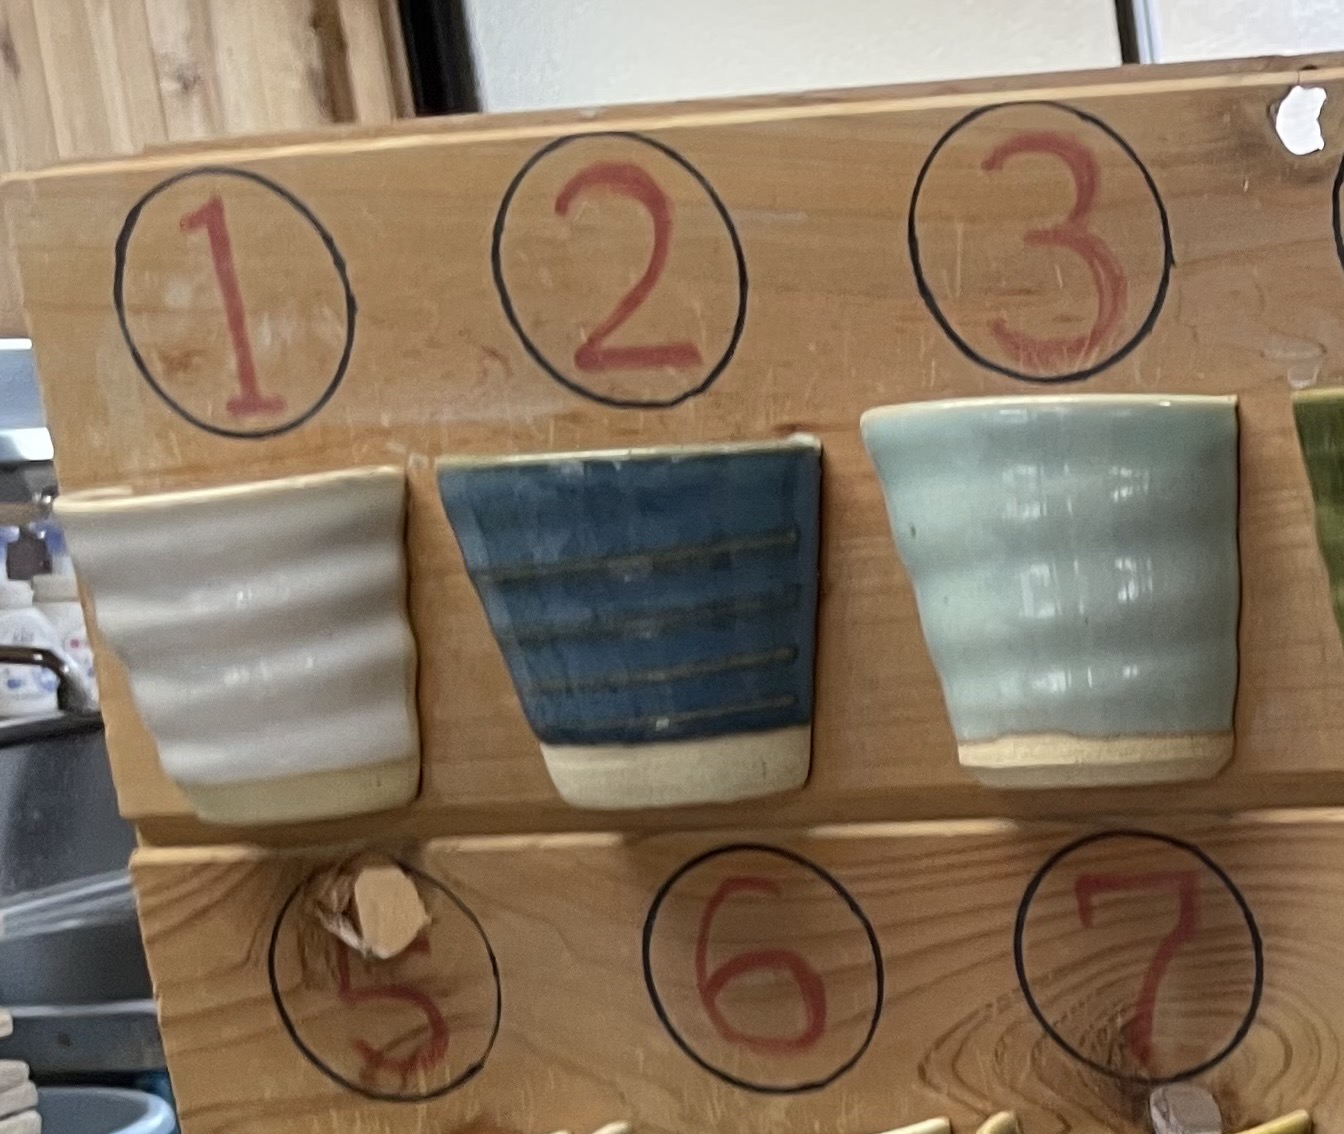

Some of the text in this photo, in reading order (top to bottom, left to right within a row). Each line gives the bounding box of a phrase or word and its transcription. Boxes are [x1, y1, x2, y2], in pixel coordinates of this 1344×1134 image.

[179, 188, 287, 418] 1
[554, 159, 703, 372] 2
[981, 130, 1128, 366] 3
[696, 876, 827, 1055] 6
[1074, 870, 1198, 1066] 7
